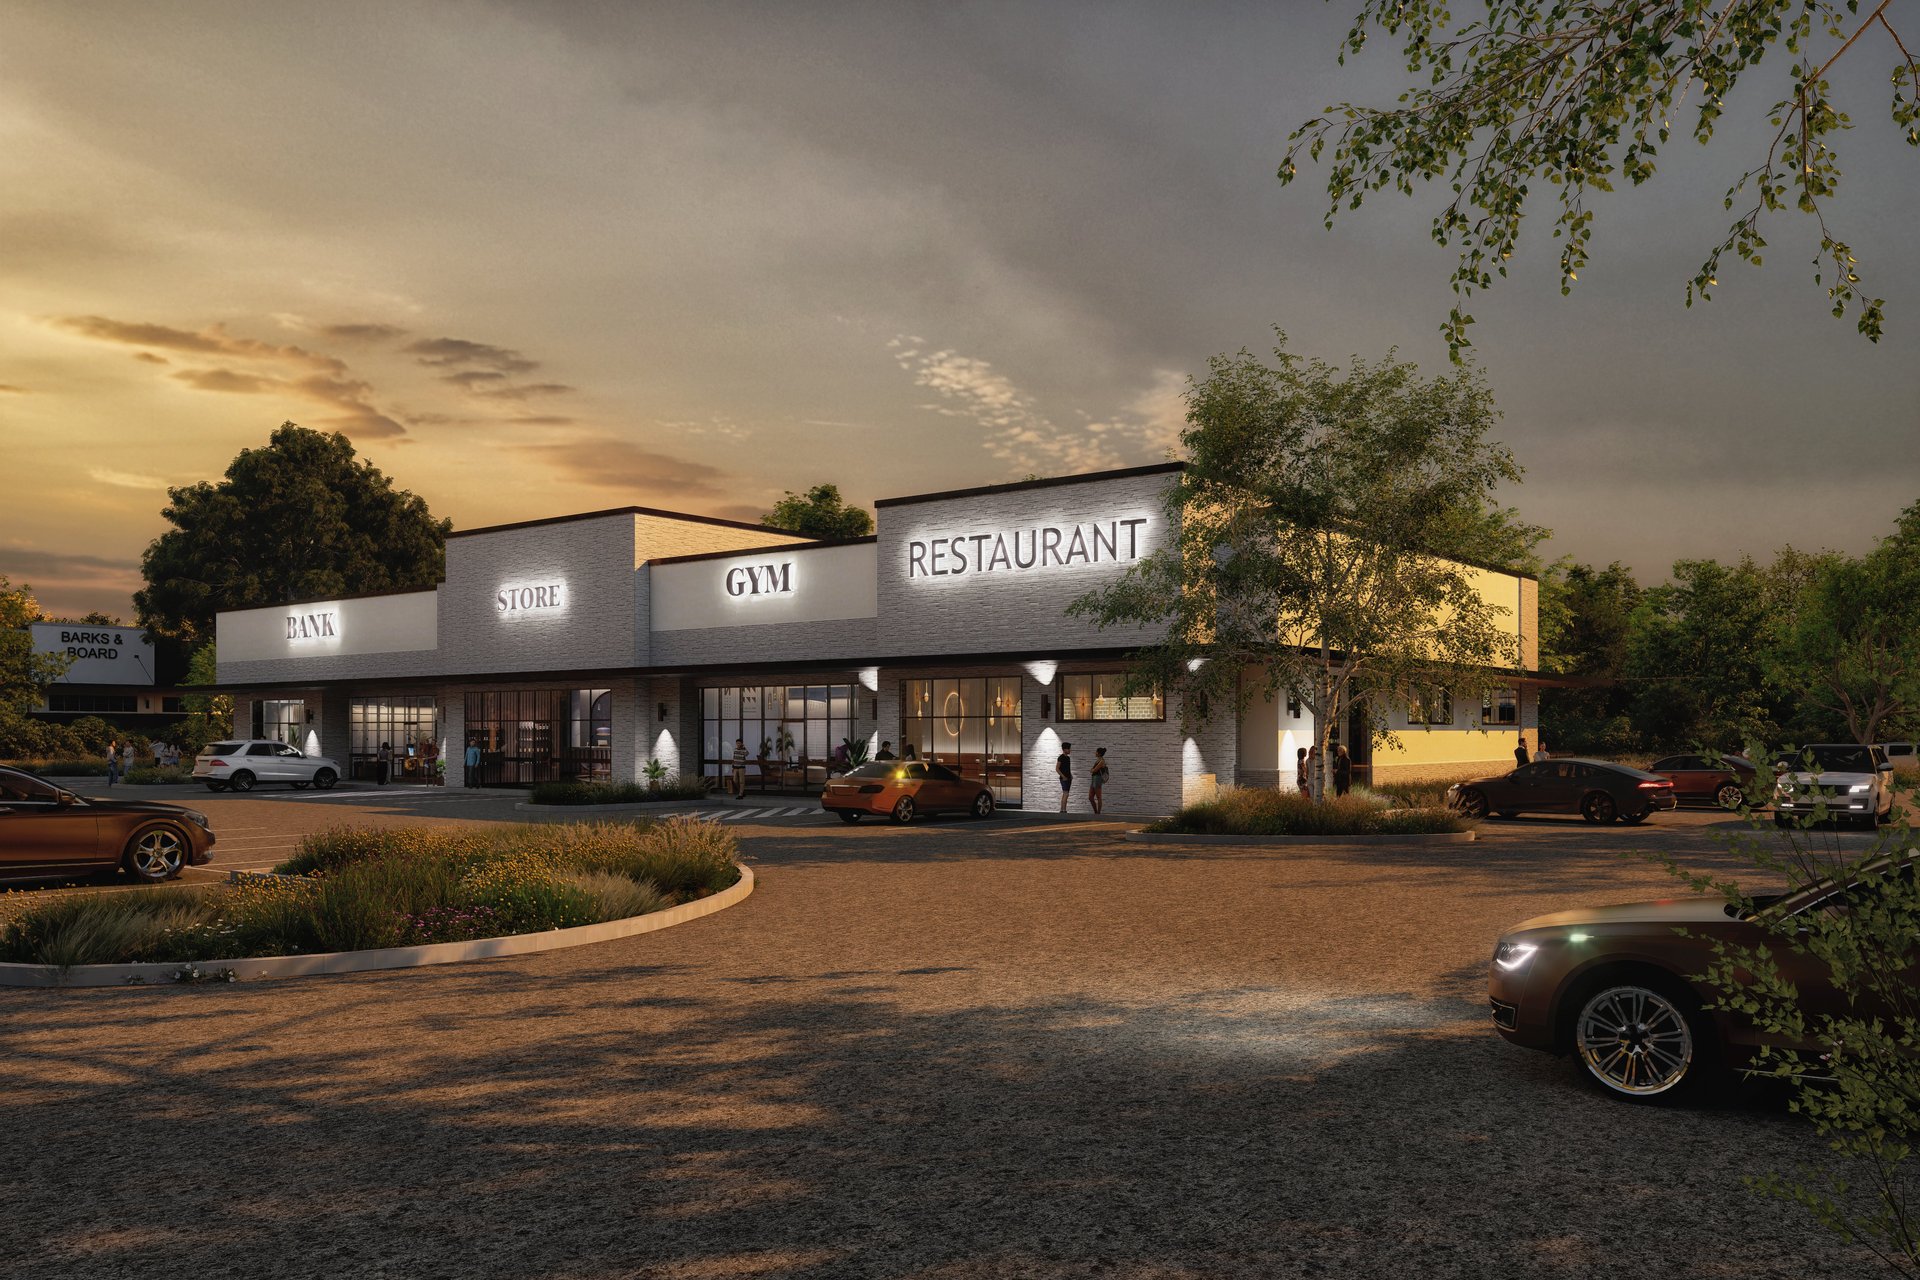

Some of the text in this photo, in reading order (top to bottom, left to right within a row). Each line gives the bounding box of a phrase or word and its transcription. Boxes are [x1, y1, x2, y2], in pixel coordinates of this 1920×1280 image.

[909, 518, 1147, 578] RESTAURANT
[726, 563, 791, 596] GYM
[497, 585, 560, 611] STORE
[61, 631, 123, 645] BARKS &
[286, 613, 335, 639] BANK
[67, 647, 118, 660] BOARD
